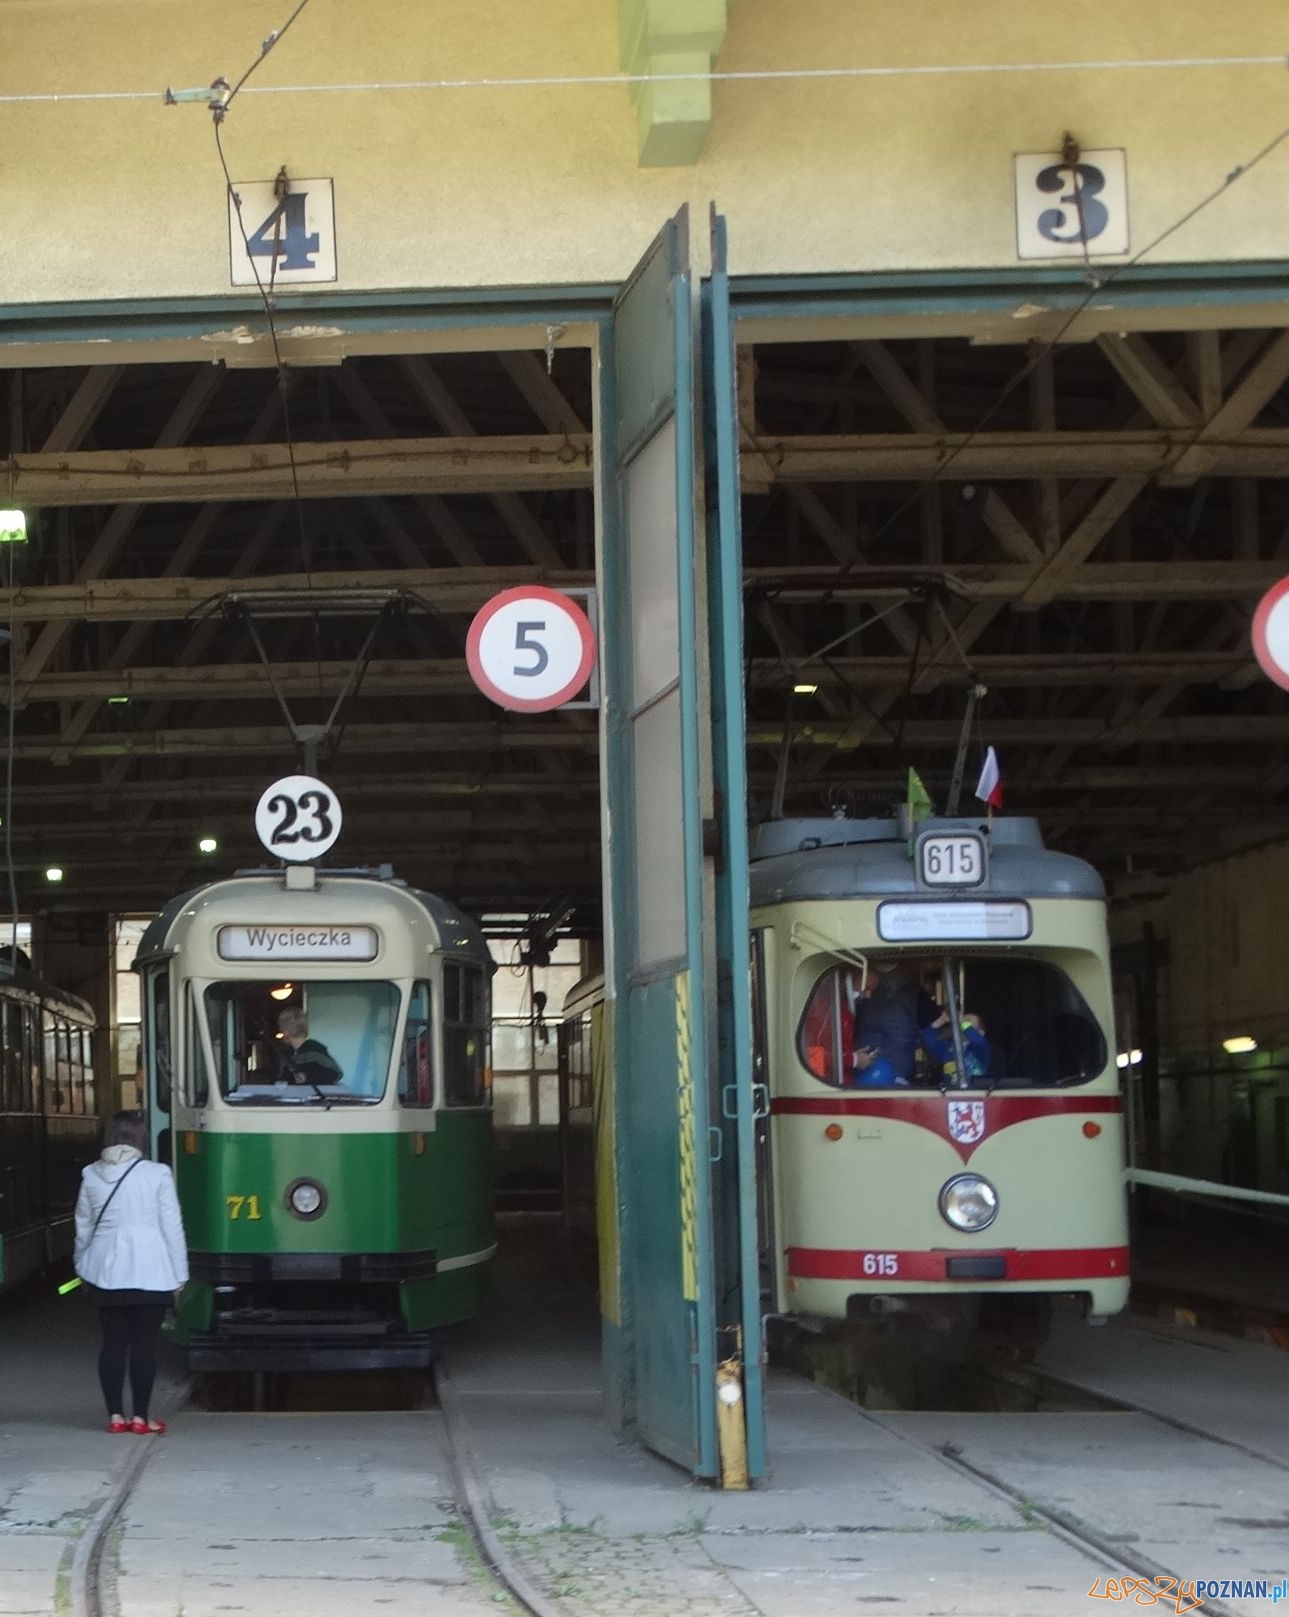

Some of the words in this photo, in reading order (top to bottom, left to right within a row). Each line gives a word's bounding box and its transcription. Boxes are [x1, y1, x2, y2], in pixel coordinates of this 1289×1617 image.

[1036, 164, 1109, 244] 3
[246, 192, 320, 271] 4
[513, 621, 549, 677] 5
[267, 791, 333, 845] 23
[927, 844, 973, 874] 615
[247, 928, 351, 950] Wycieczka
[226, 1195, 261, 1220] 71
[863, 1254, 899, 1275] 615
